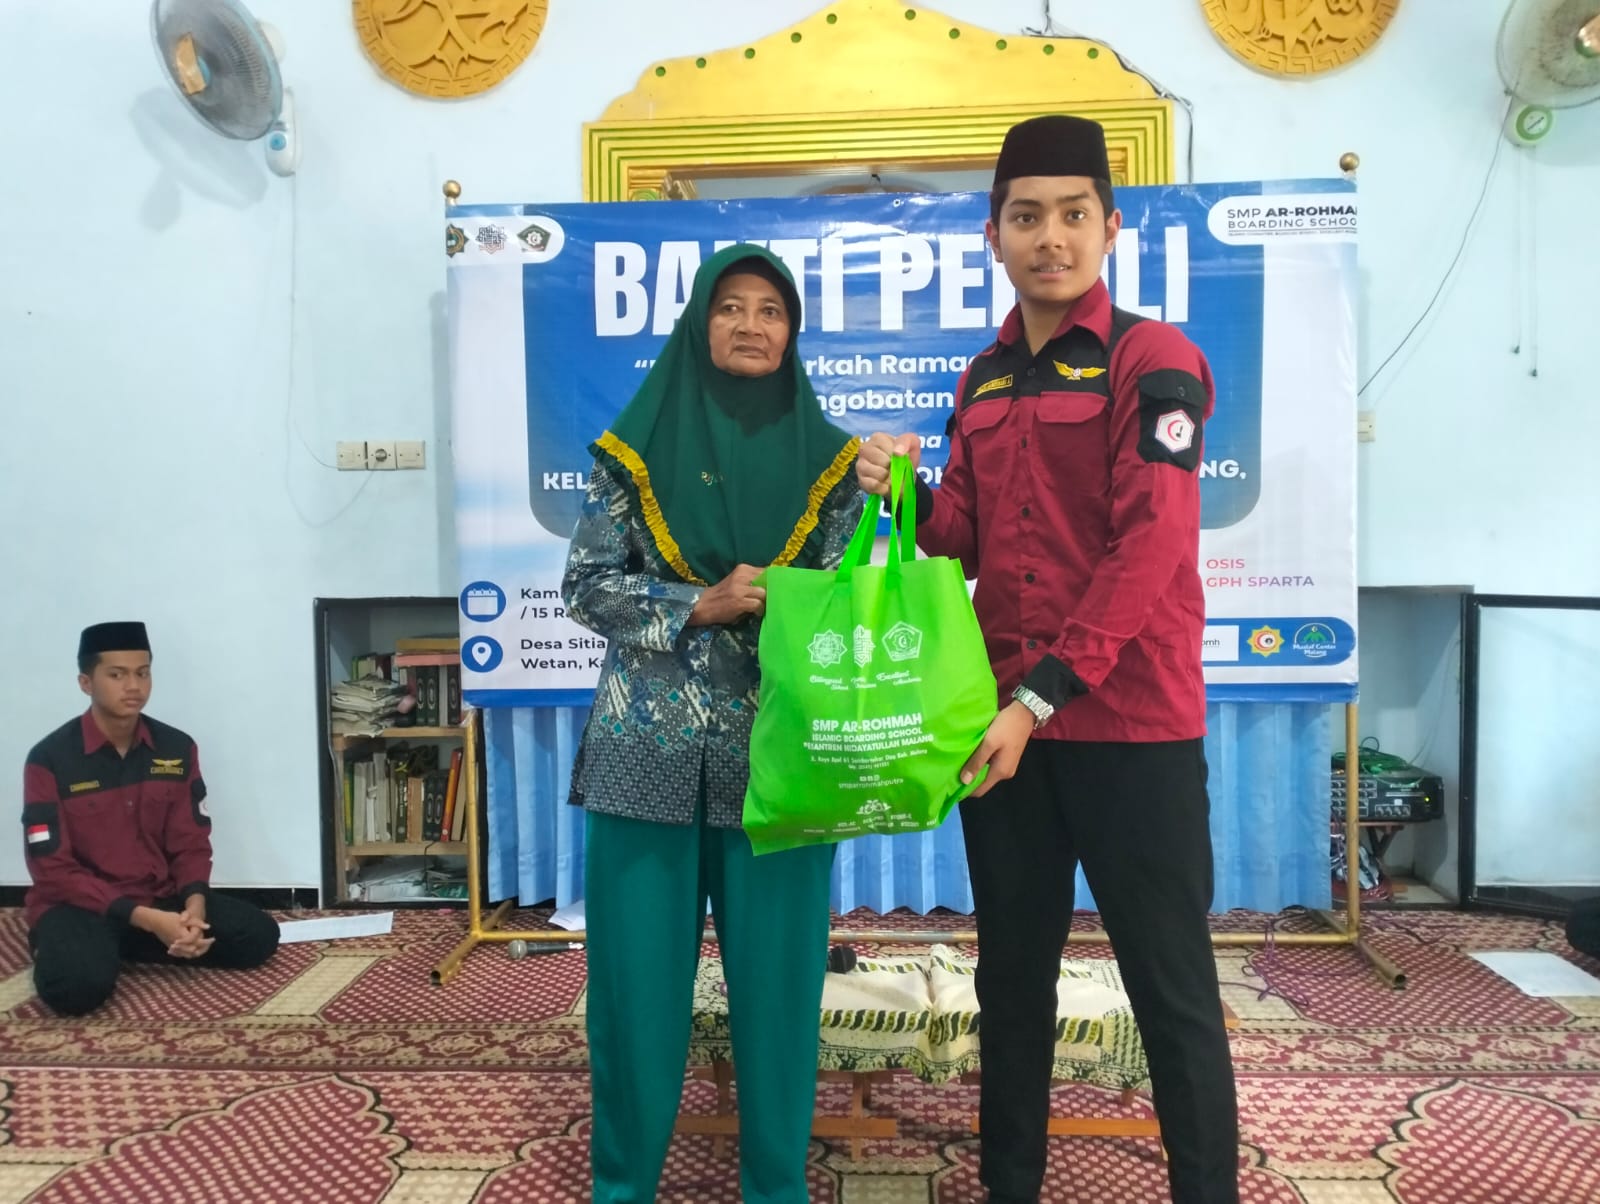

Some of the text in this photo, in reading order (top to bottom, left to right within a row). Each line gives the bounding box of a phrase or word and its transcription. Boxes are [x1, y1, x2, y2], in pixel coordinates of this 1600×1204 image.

[1227, 205, 1357, 219] SMP AR-ROHMA
[1228, 216, 1357, 229] BOARDING SCHOO
[880, 225, 1189, 331] PELI
[806, 354, 978, 376] rkah Rama
[1206, 558, 1245, 570] OSIS
[1206, 575, 1315, 588] GPH SPARTA
[520, 588, 562, 599] Kam
[532, 607, 548, 618] 15
[521, 637, 606, 650] Desa Sitia
[521, 657, 583, 670] Wetan,
[812, 712, 922, 732] SMP AR-ROHMAH
[812, 727, 923, 742] ISLAMIC BOARDING SCHOOL
[844, 740, 900, 752] HIDAYATULLAH
[901, 733, 935, 746] MALANG
